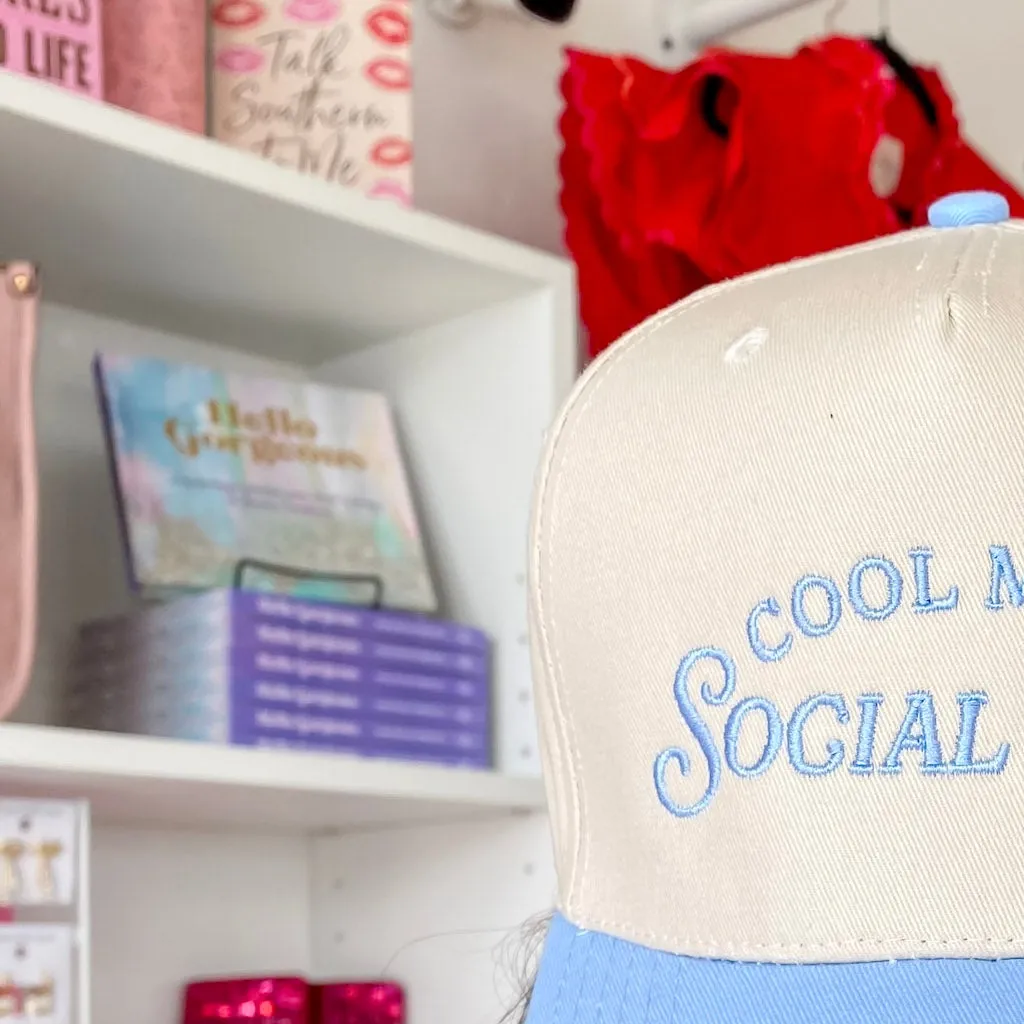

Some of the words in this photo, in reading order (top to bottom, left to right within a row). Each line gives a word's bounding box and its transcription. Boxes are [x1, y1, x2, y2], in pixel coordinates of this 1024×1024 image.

[24, 27, 90, 88] LIFE
[256, 24, 352, 81] Talk
[222, 78, 390, 133] Southern
[208, 399, 318, 438] Hello
[746, 547, 960, 663] COOL
[652, 647, 1011, 818] SOCIAL
